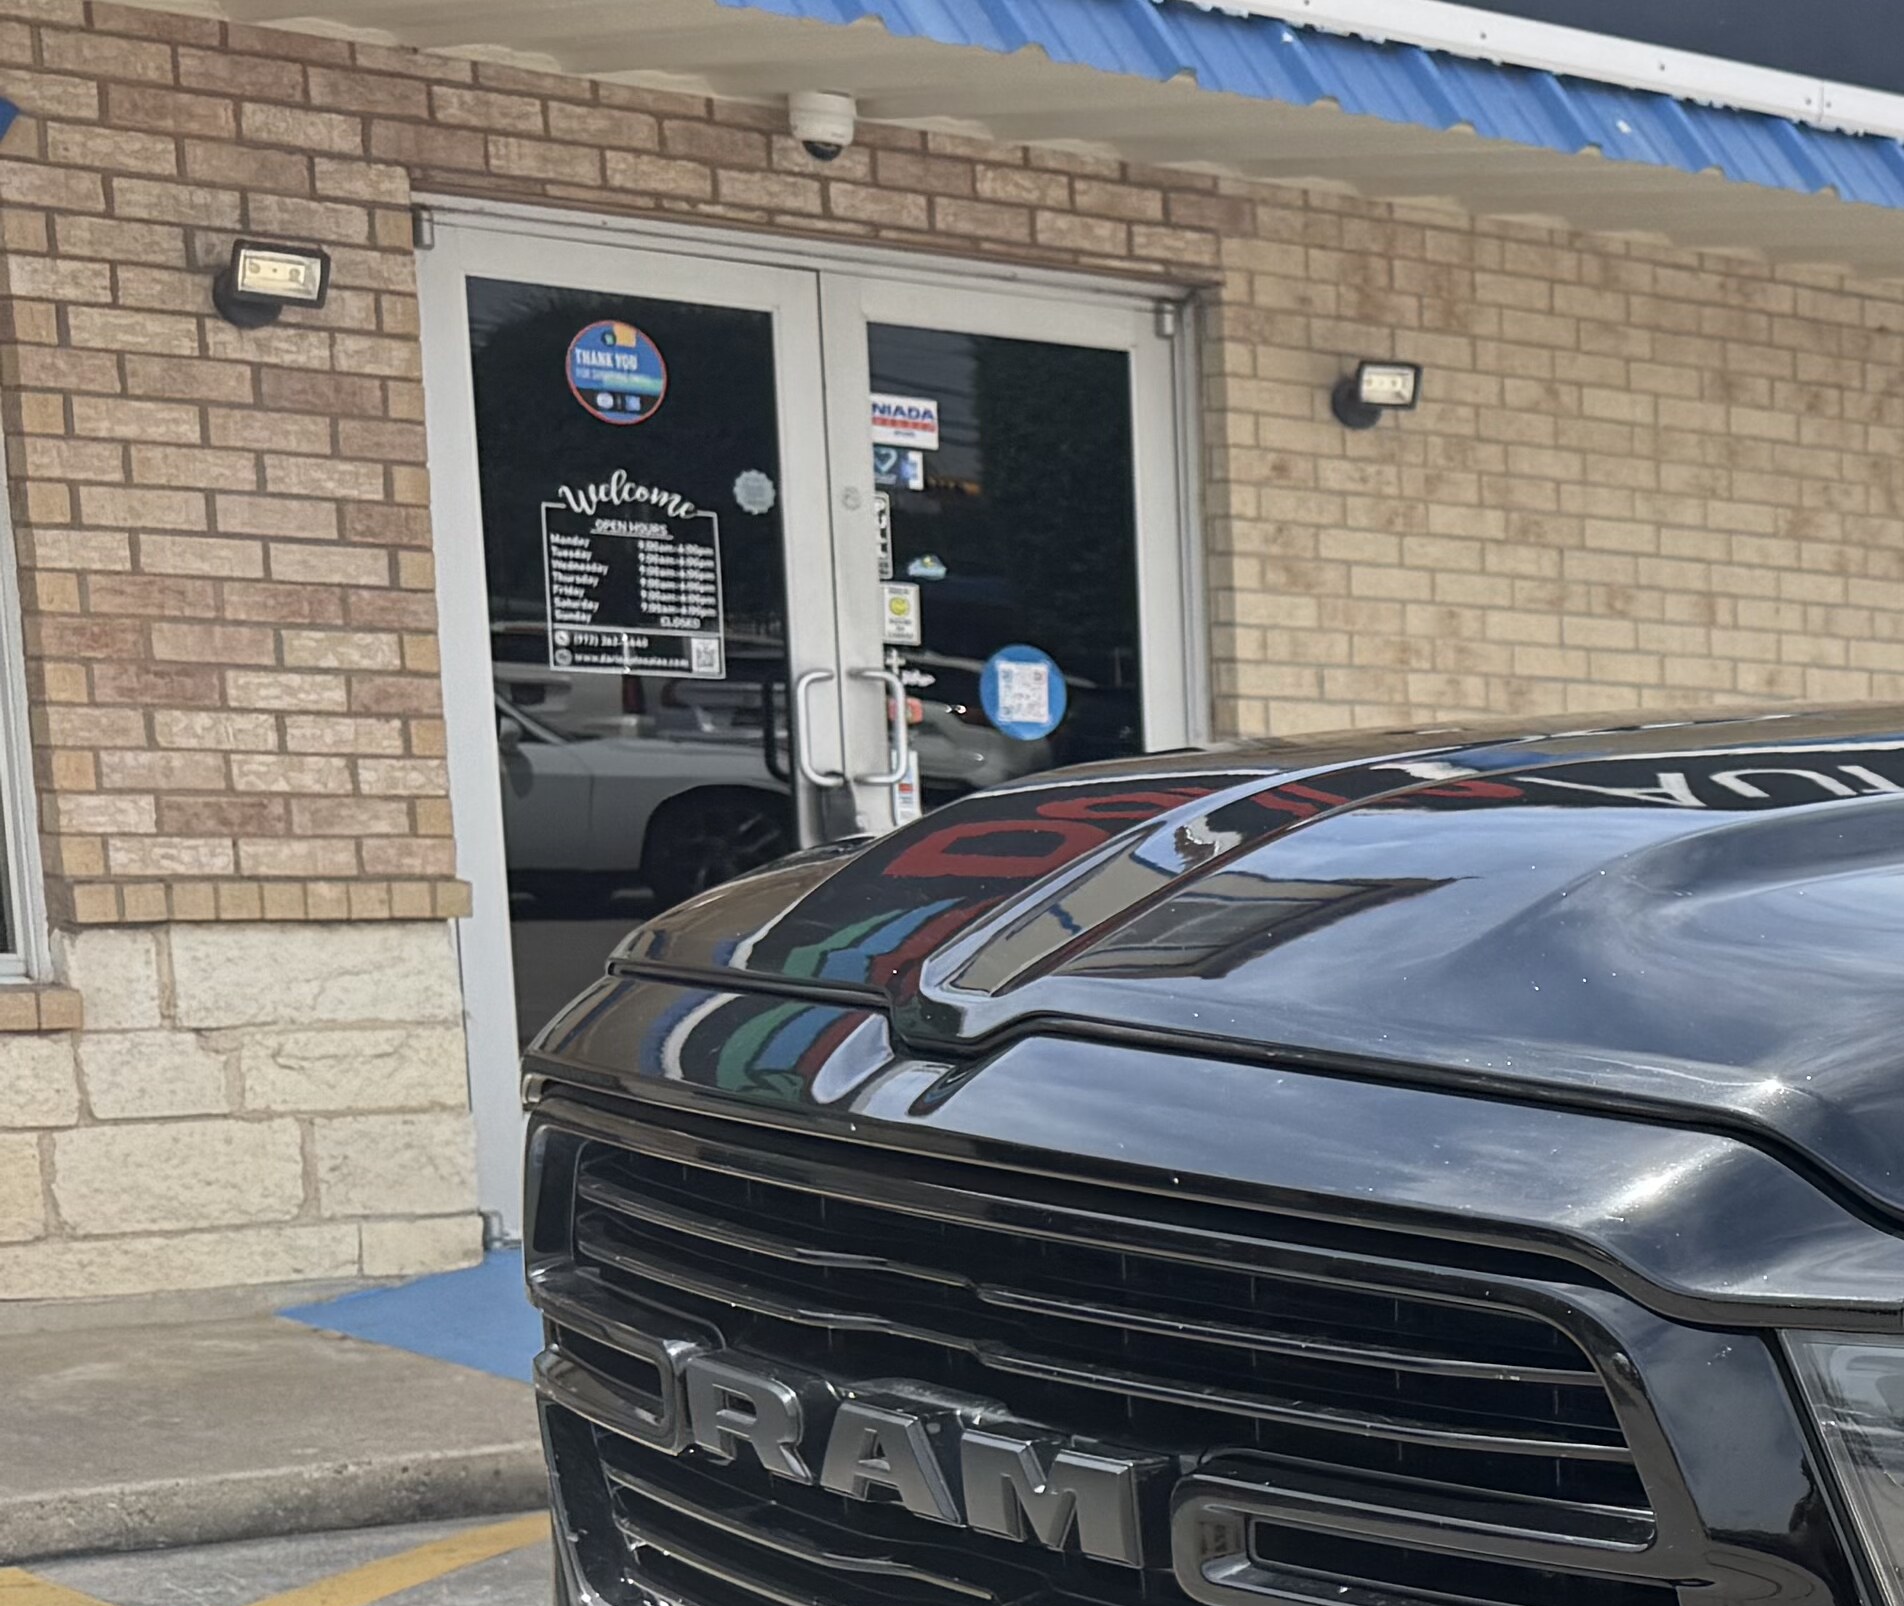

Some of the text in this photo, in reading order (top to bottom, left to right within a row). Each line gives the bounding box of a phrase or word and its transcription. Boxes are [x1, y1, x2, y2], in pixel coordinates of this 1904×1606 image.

[575, 347, 638, 371] THANK YOU
[872, 402, 935, 420] NIADA
[558, 469, 696, 518] Welcome
[594, 518, 668, 537] OPEN HOURS
[684, 1351, 1145, 1569] RAM
